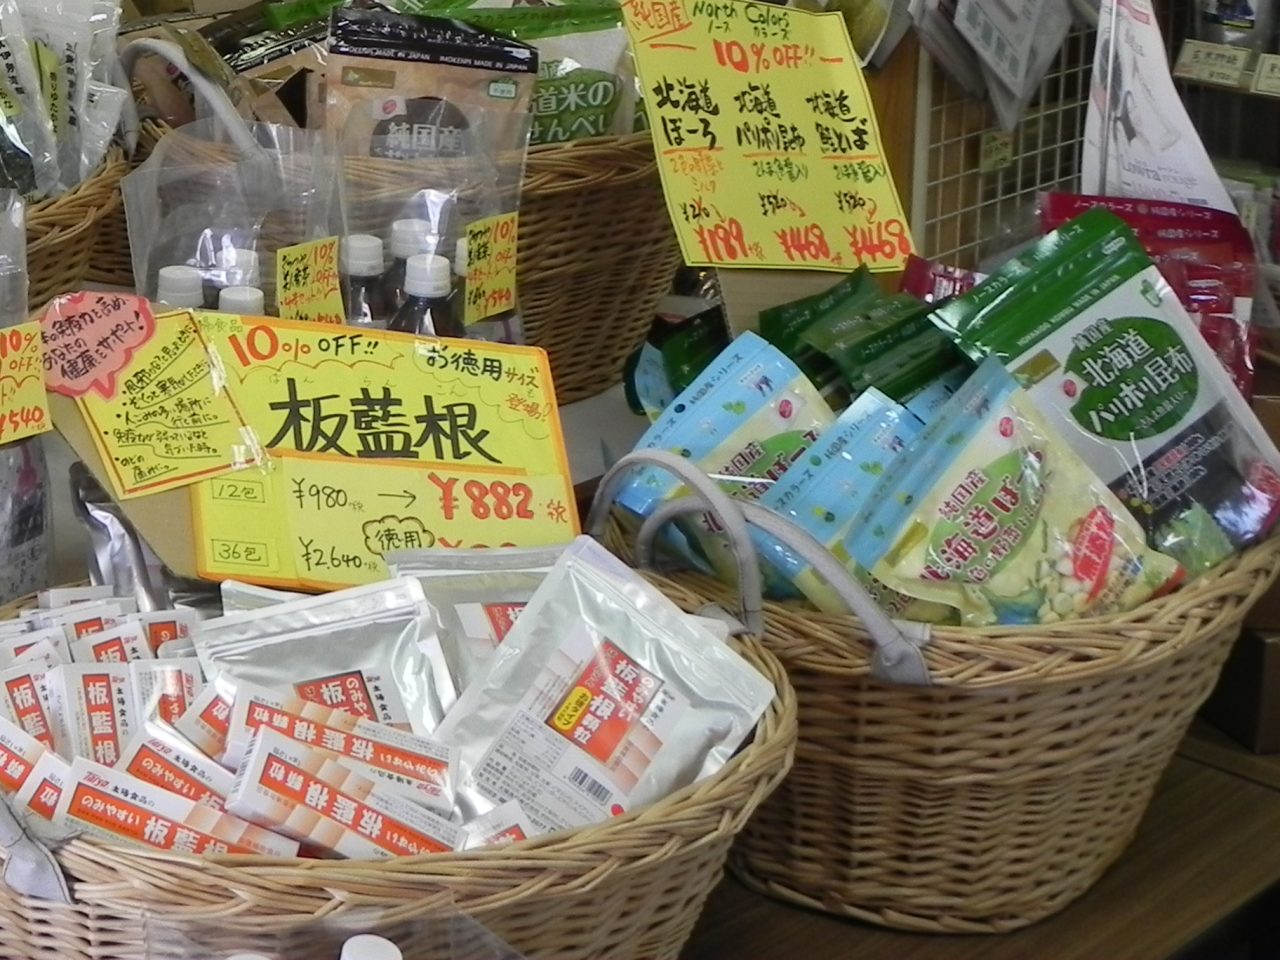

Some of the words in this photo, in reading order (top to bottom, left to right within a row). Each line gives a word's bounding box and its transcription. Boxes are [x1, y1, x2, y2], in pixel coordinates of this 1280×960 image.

[692, 1, 739, 20] North
[694, 216, 749, 264] ¥189
[774, 223, 831, 263] ¥468
[0, 328, 39, 360] 10%
[228, 324, 312, 368] 10%
[318, 334, 380, 357] OFF!!
[1081, 328, 1155, 389] 北海道
[1088, 345, 1195, 434] パリポリ昆布
[266, 376, 504, 465] 板藍根
[217, 482, 260, 500] 12包
[291, 477, 349, 511] ¥980
[427, 471, 535, 522] ¥882
[218, 542, 264, 563] 36包
[373, 527, 424, 552] 徳用
[86, 680, 118, 767] 板藍根
[79, 794, 141, 826] のみやすい
